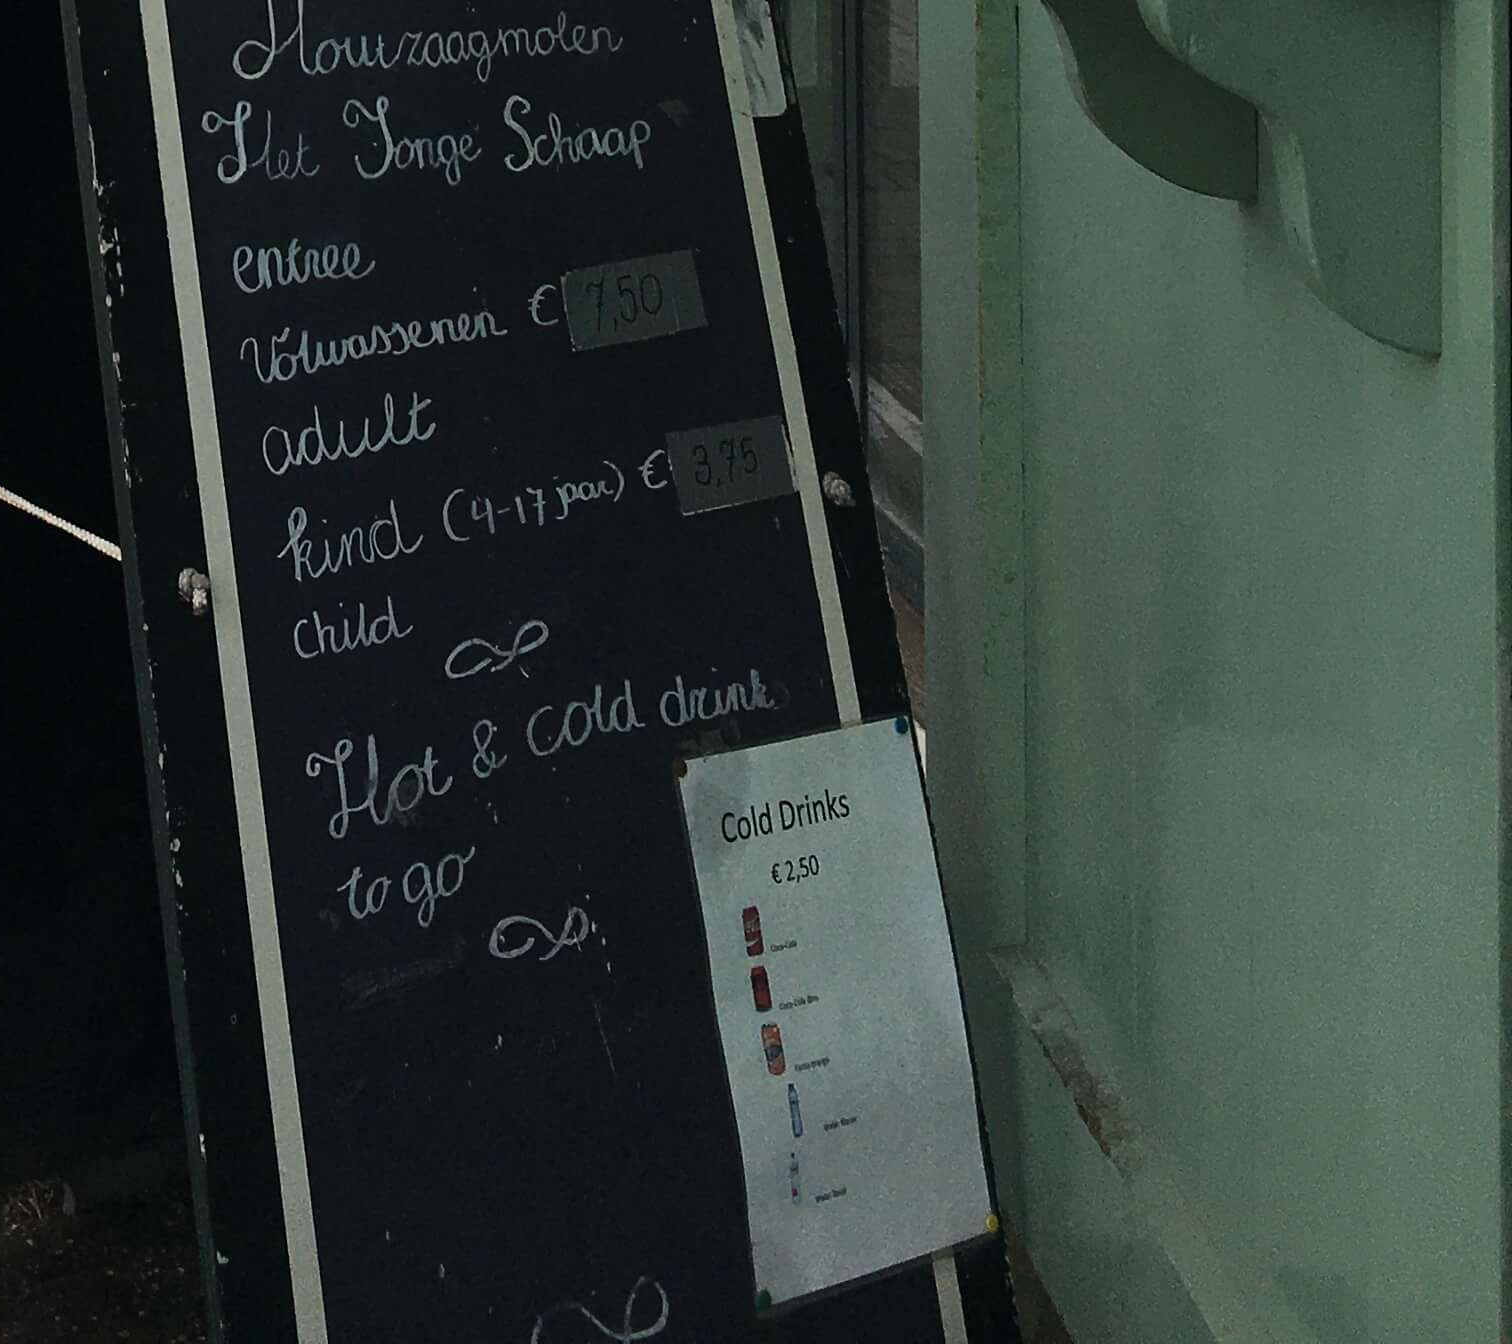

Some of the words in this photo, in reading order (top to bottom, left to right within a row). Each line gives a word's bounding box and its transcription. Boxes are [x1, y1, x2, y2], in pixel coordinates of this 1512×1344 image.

[201, 100, 320, 185] Het
[343, 96, 482, 186] Jonge
[502, 94, 652, 173] Schaap
[232, 238, 376, 293] entree
[262, 391, 437, 476] adult
[276, 499, 424, 582] kind
[306, 735, 453, 839] Hot
[471, 719, 507, 778] &
[720, 799, 774, 843] Cold
[780, 788, 851, 835] Drinks
[771, 865, 782, 885] €
[785, 853, 820, 885] 2,50
